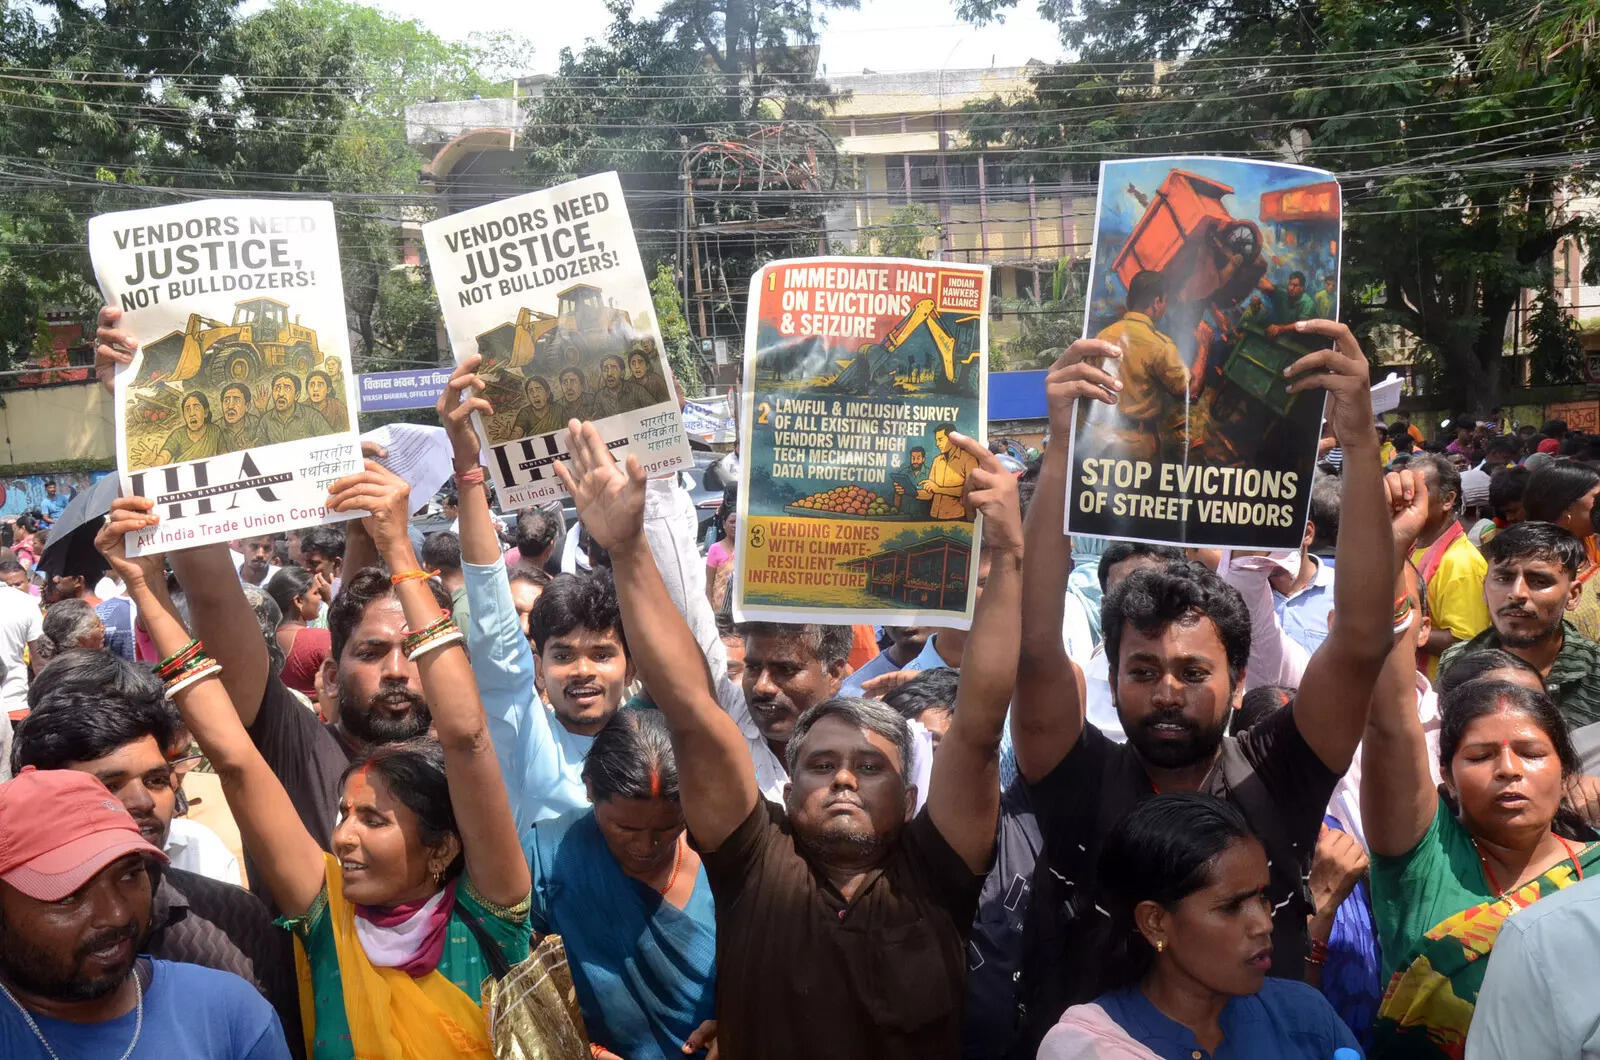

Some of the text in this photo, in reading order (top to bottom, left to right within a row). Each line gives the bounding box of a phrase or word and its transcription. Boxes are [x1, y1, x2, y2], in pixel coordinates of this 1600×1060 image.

[113, 216, 316, 250] VENDORS NEED
[444, 191, 609, 253] VENDORS NEED
[124, 239, 302, 286] JUSTICE,
[460, 221, 605, 285] JUSTICE,
[458, 250, 620, 308] NOT BULLDOZERS!
[767, 272, 776, 291] 1
[784, 267, 936, 295] IMMEDIATE HALT
[948, 278, 975, 287] INDIAN
[120, 270, 316, 312] NOT BULLDOZERS!
[942, 287, 979, 298] HAWKERS
[782, 291, 912, 317] ON EVICTIONS
[942, 298, 978, 308] ALLIANCE
[780, 312, 876, 338] & SEIZURE
[640, 411, 676, 428] भारतीय
[757, 401, 771, 424] 2
[775, 399, 959, 422] LAWFUL & INCLUSIVE SURVEY
[775, 415, 926, 437] OF ALL EXISTING STREET
[309, 443, 353, 461] भारतीय
[774, 431, 906, 452] VENDORS WITH HIGH
[299, 458, 356, 478] पथविक्रेता
[640, 456, 682, 473] ngress
[773, 448, 901, 468] TECH MECHANISM &
[772, 463, 886, 483] DATA PROTECTION
[1081, 457, 1299, 500] STOP EVICTIONS
[158, 491, 193, 503] INDIAN
[245, 473, 292, 488] ALLIANCE
[509, 492, 524, 504] All
[527, 486, 555, 499] India
[1079, 490, 1294, 528] OF STREET VENDORS
[137, 533, 155, 548] All
[160, 530, 195, 544] India
[199, 520, 238, 536] Trade
[244, 512, 284, 529] Union
[750, 524, 766, 548] 3
[770, 522, 880, 540] VENDING ZONES
[768, 539, 871, 556] WITH CLIMATE-
[767, 555, 836, 570] RESILIENT
[748, 570, 866, 587] INFRASTRUCTURE
